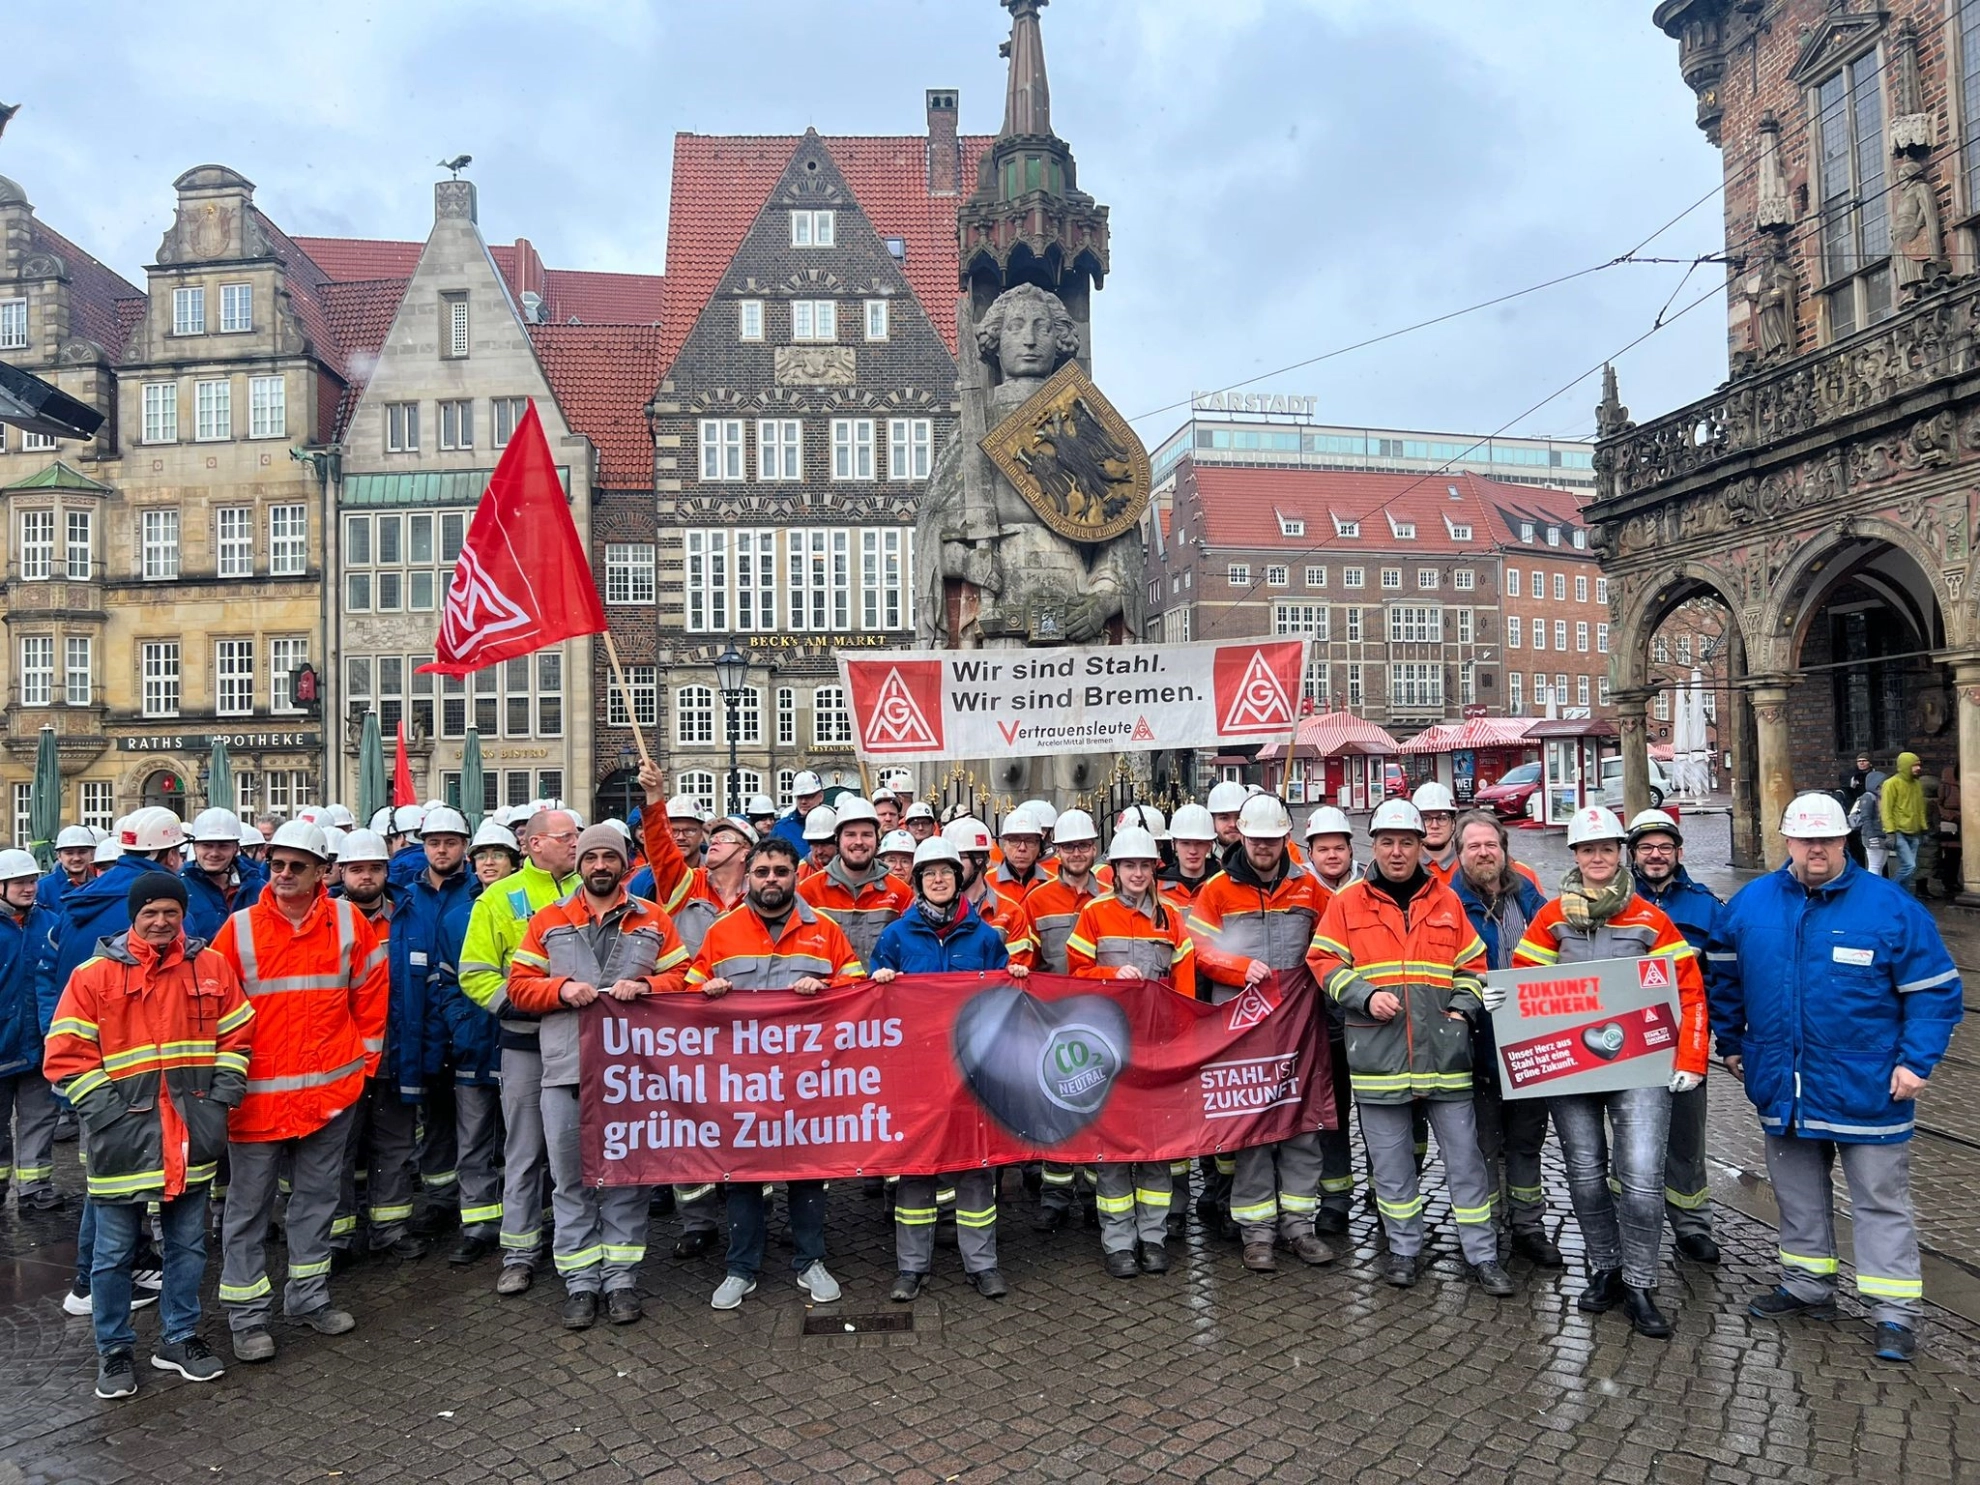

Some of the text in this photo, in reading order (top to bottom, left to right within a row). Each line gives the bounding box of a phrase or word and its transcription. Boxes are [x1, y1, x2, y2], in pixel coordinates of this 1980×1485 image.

[1191, 391, 1318, 414] KARSTADT
[750, 635, 887, 647] BECK's AM MARKT
[952, 654, 1167, 683] Wir sind Stahl.
[951, 684, 1203, 712] Wir sind Bremen.
[128, 737, 183, 749] RATHS
[997, 720, 1132, 746] Vertrauensleute
[1037, 736, 1113, 747] ArcelorMittal Bremen
[501, 748, 549, 758] BISTRO
[1455, 777, 1473, 788] WET
[1516, 976, 1601, 1000] ZUKUNFT
[1519, 996, 1605, 1018] SICHERN.
[602, 1017, 903, 1057] Unser Herz aus
[1507, 1038, 1572, 1062] Unser Herz aus
[1511, 1048, 1571, 1072] Stahl hat eine
[602, 1059, 881, 1105] Stahl hat eine
[1059, 1067, 1106, 1096] NEUTRAL
[1200, 1056, 1299, 1090] STAHL IST
[1514, 1058, 1579, 1083] grüne Zukunft.
[1203, 1077, 1300, 1111] ZUKUNFT
[602, 1102, 905, 1161] grüne Zukunft.
